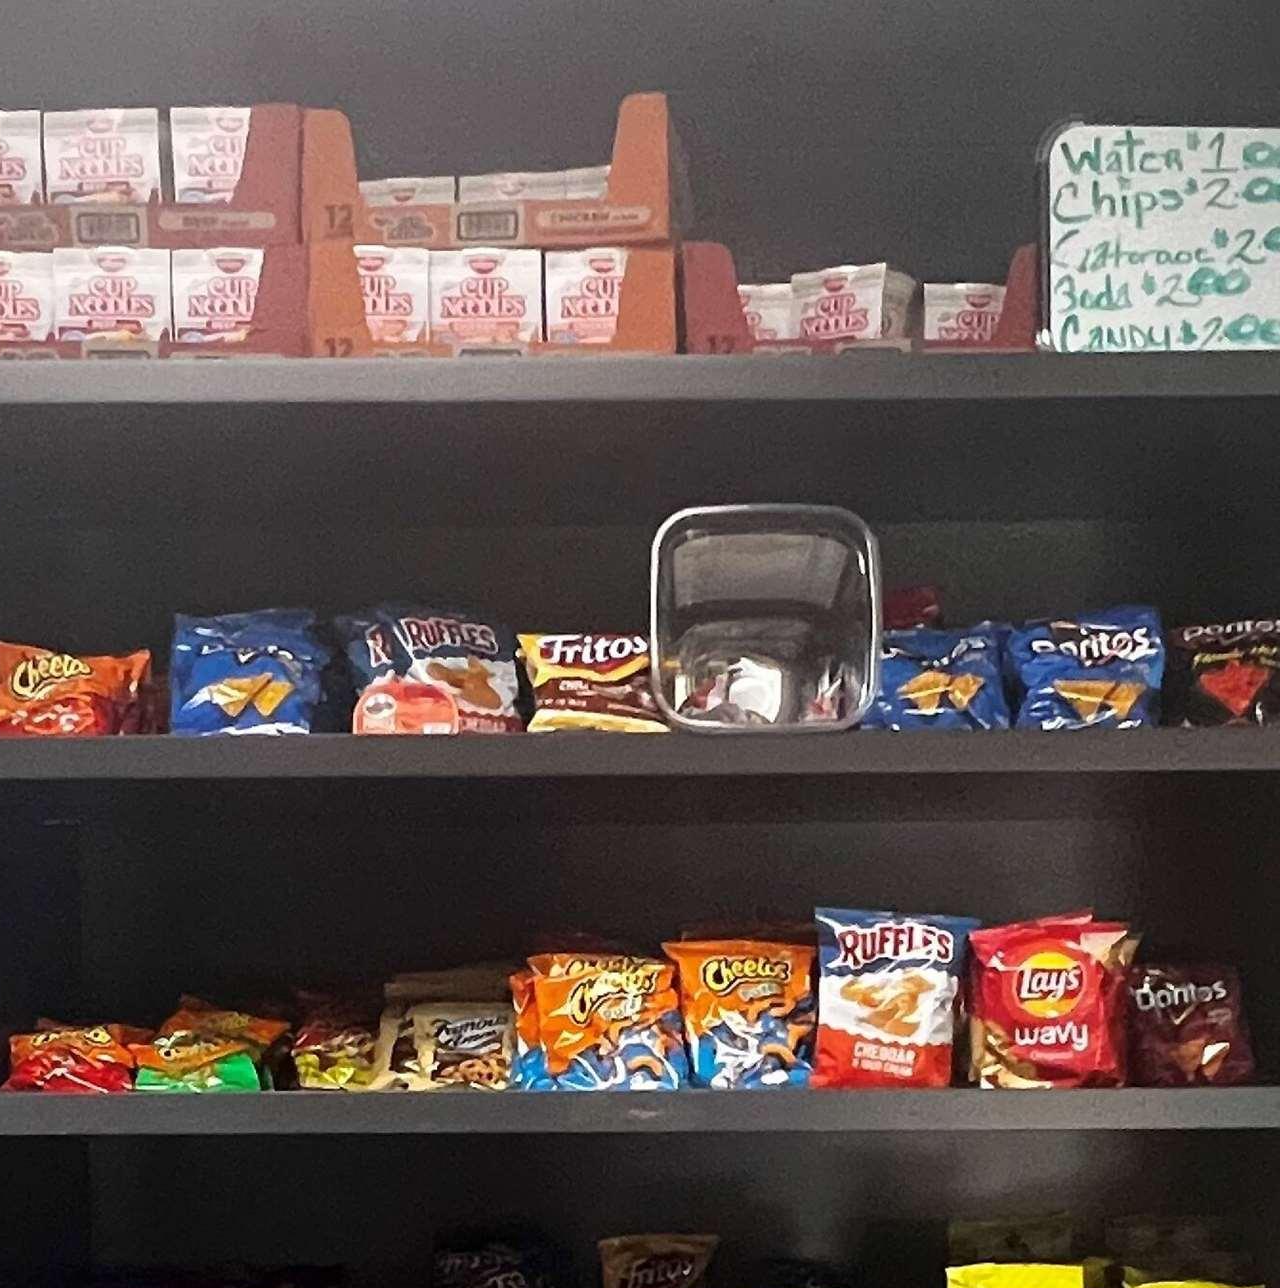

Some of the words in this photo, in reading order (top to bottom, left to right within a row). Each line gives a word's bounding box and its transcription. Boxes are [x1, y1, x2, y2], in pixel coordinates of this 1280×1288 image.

[208, 138, 243, 158] CU
[188, 156, 242, 178] NOOD
[89, 278, 136, 297] CUP
[460, 277, 509, 297] CUP
[69, 296, 155, 318] NOODLES
[440, 296, 527, 318] NOODLES
[561, 297, 619, 318] NOOD
[539, 635, 650, 664] Fritos
[838, 926, 952, 966] RUFFLES
[702, 956, 790, 993] Cheetos
[1014, 1021, 1089, 1051] wavy
